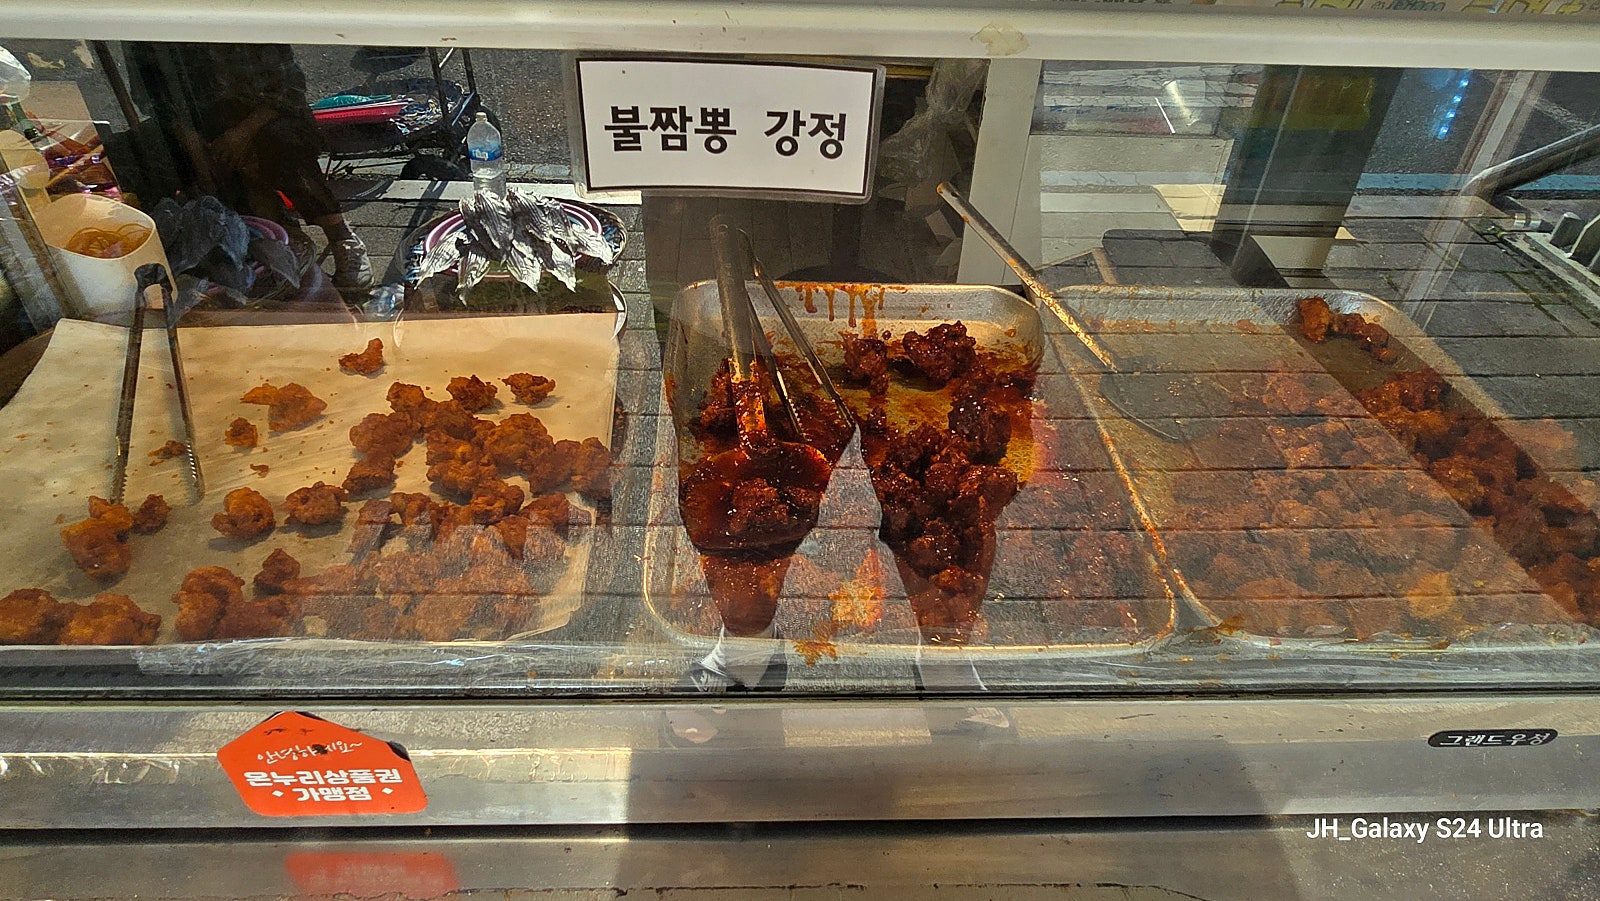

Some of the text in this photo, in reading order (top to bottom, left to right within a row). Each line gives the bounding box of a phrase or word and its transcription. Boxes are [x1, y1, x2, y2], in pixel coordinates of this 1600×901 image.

[604, 105, 847, 160] 불짬뽕 강정
[243, 768, 403, 787] 온누리상품권
[292, 786, 372, 802] 가맹점
